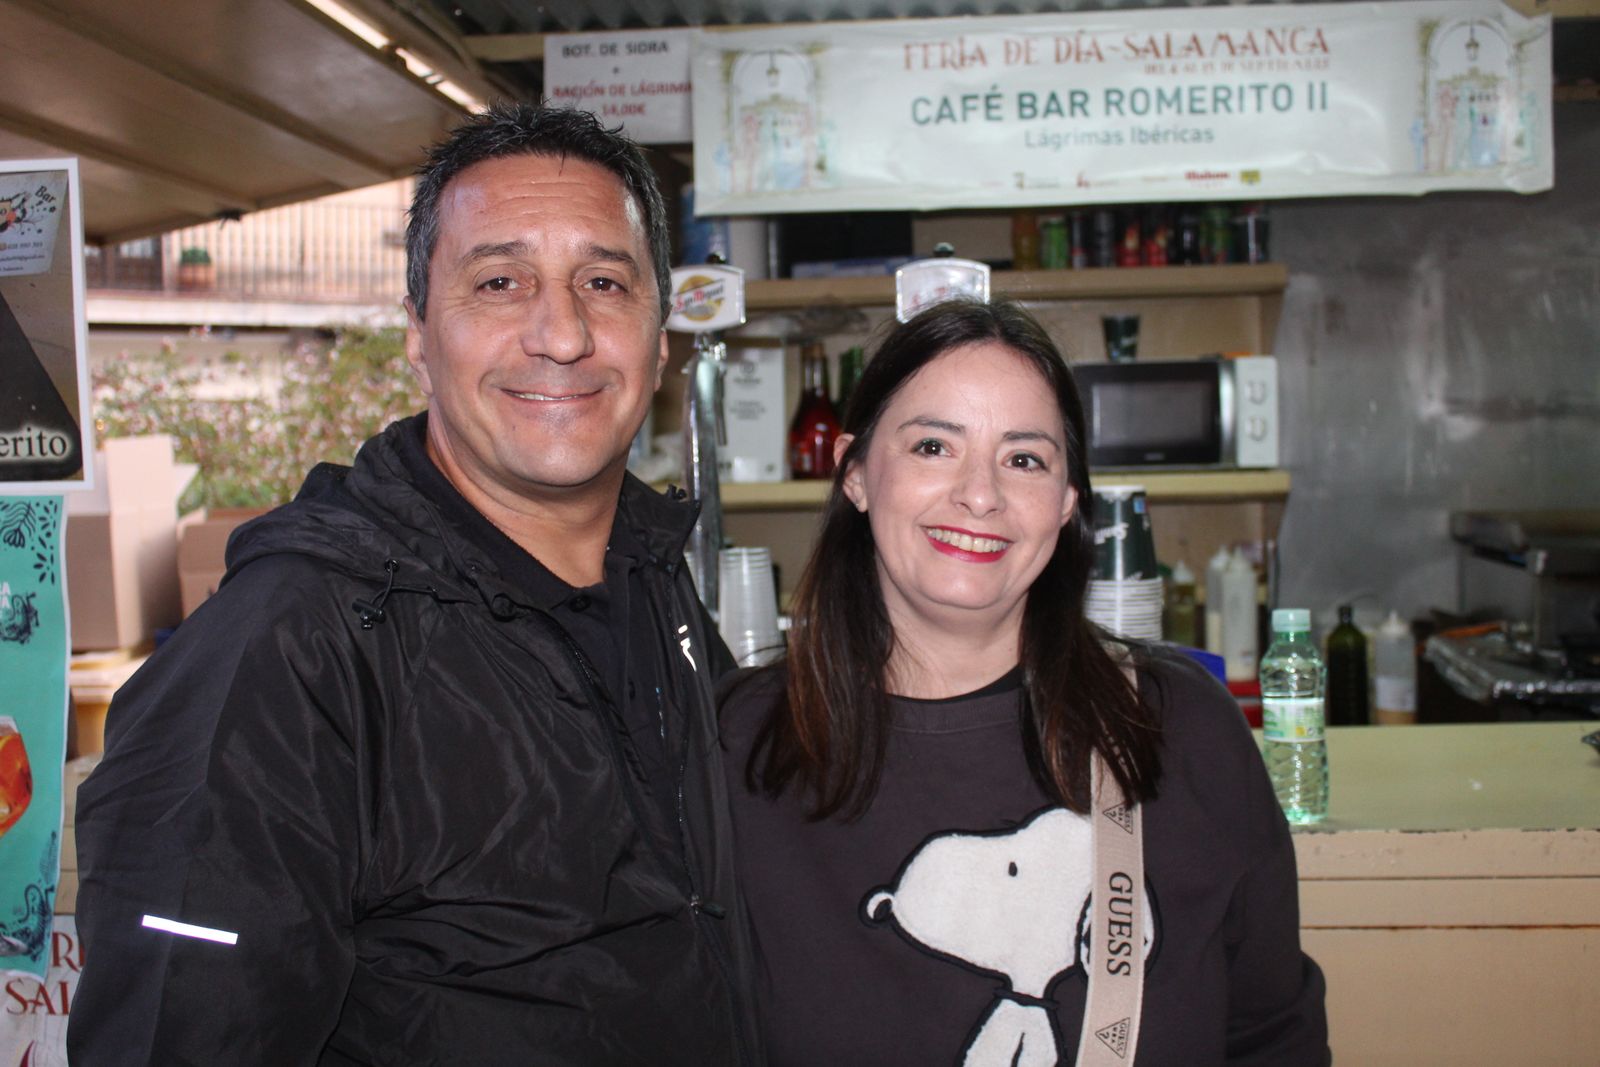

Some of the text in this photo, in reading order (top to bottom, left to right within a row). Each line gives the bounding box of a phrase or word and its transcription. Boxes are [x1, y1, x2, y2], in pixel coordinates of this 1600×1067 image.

[600, 43, 617, 56] DE
[625, 41, 669, 56] SIDRA
[1004, 38, 1039, 65] DE
[553, 79, 604, 98] RACIÓN
[609, 84, 625, 96] DE
[912, 81, 1328, 125] CAFÉ BAR ROMERITO II
[1025, 123, 1214, 150] Lágrimas Ibéricas
[35, 185, 57, 203] Bar
[1107, 872, 1133, 976] GUESS
